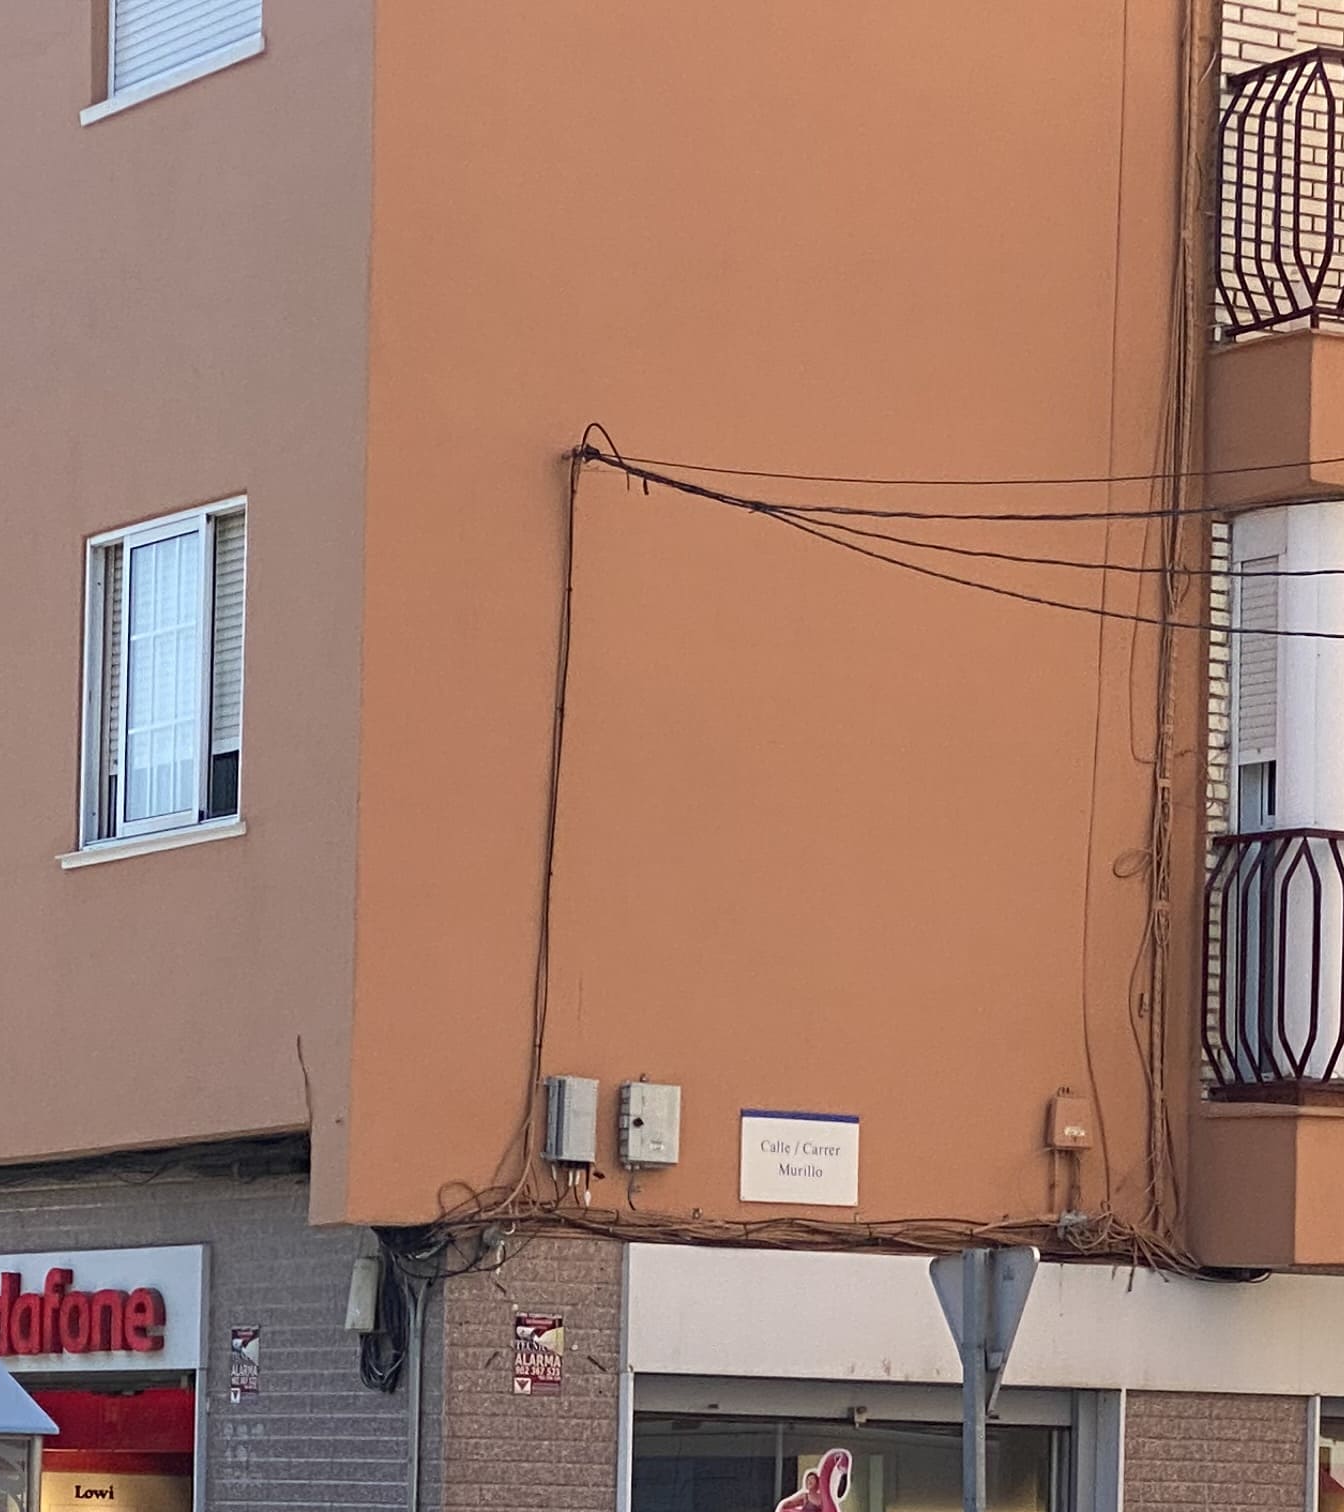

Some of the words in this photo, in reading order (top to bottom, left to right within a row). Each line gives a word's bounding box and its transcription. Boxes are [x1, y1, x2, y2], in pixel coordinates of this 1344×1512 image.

[760, 1139, 791, 1154] Calle
[794, 1141, 800, 1156] /
[802, 1142, 841, 1157] Carrer
[778, 1163, 823, 1178] Murillo
[515, 1352, 561, 1368] ALARMA
[74, 1484, 115, 1500] Lowi
